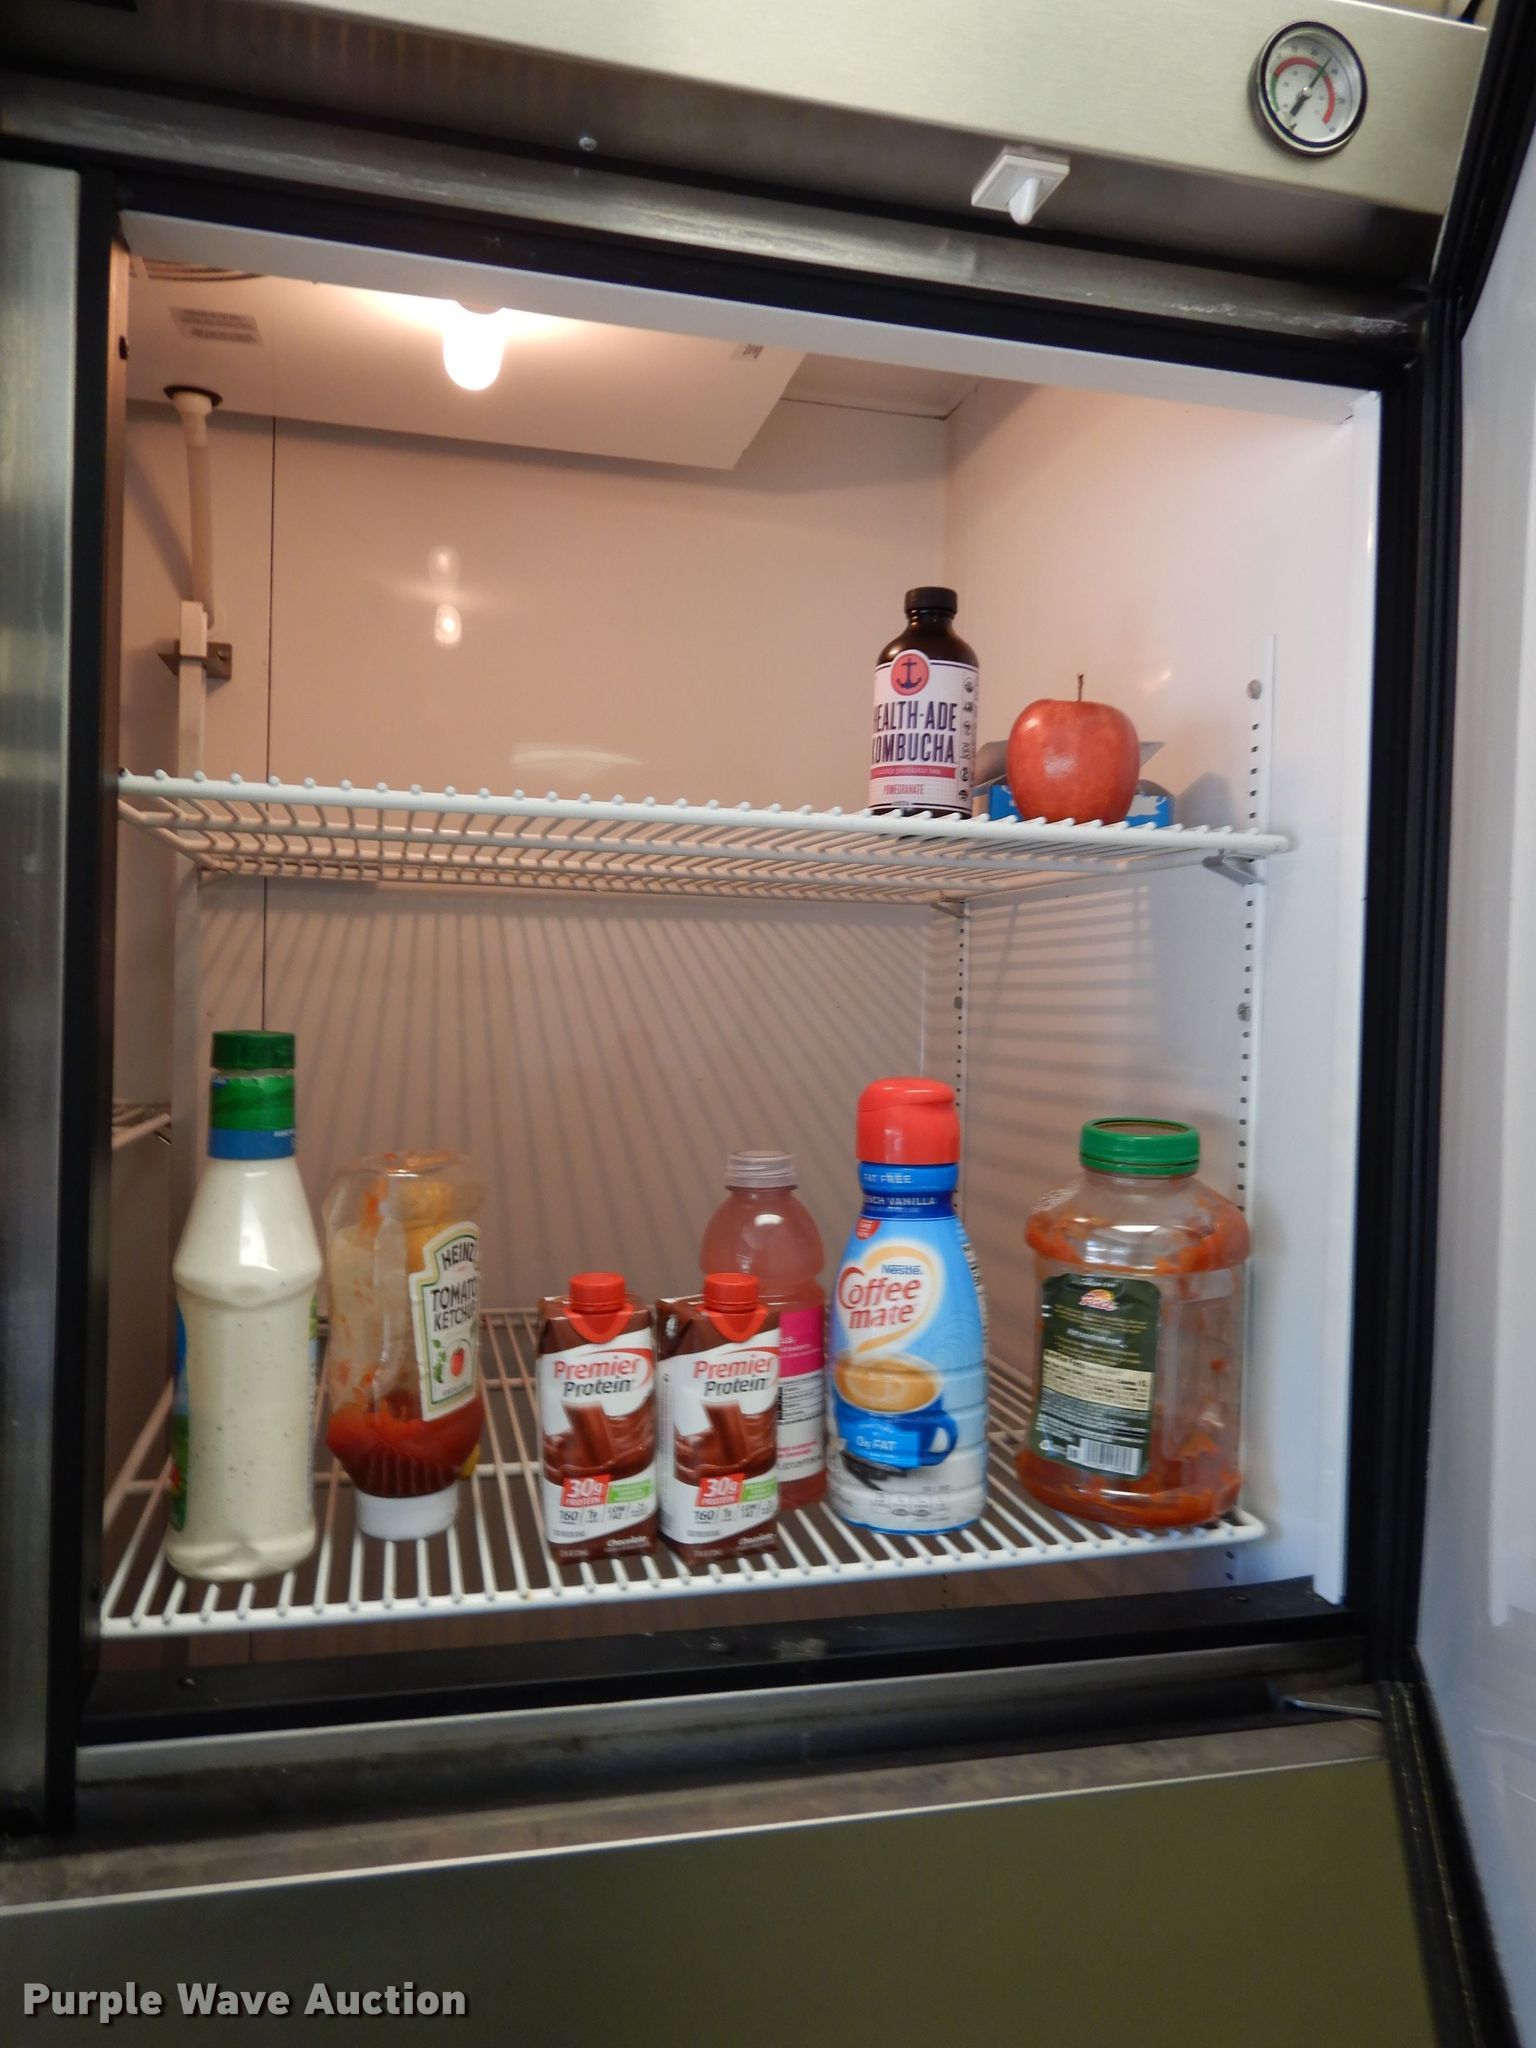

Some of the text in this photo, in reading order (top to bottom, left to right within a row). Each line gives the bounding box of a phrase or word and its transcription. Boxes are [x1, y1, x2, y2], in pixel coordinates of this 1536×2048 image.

[880, 1174, 913, 1185] FREE
[888, 1196, 936, 1207] VANILLA
[442, 1242, 475, 1271] HEINZ
[431, 1278, 478, 1312] TOMATO
[838, 1266, 921, 1310] Coffee
[848, 1303, 914, 1329] mate
[553, 1355, 641, 1379] Premier
[693, 1355, 774, 1380] Premier
[563, 1375, 632, 1397] Protein
[704, 1375, 767, 1397] Protein
[567, 1478, 604, 1498] 30g
[703, 1477, 739, 1497] 30g
